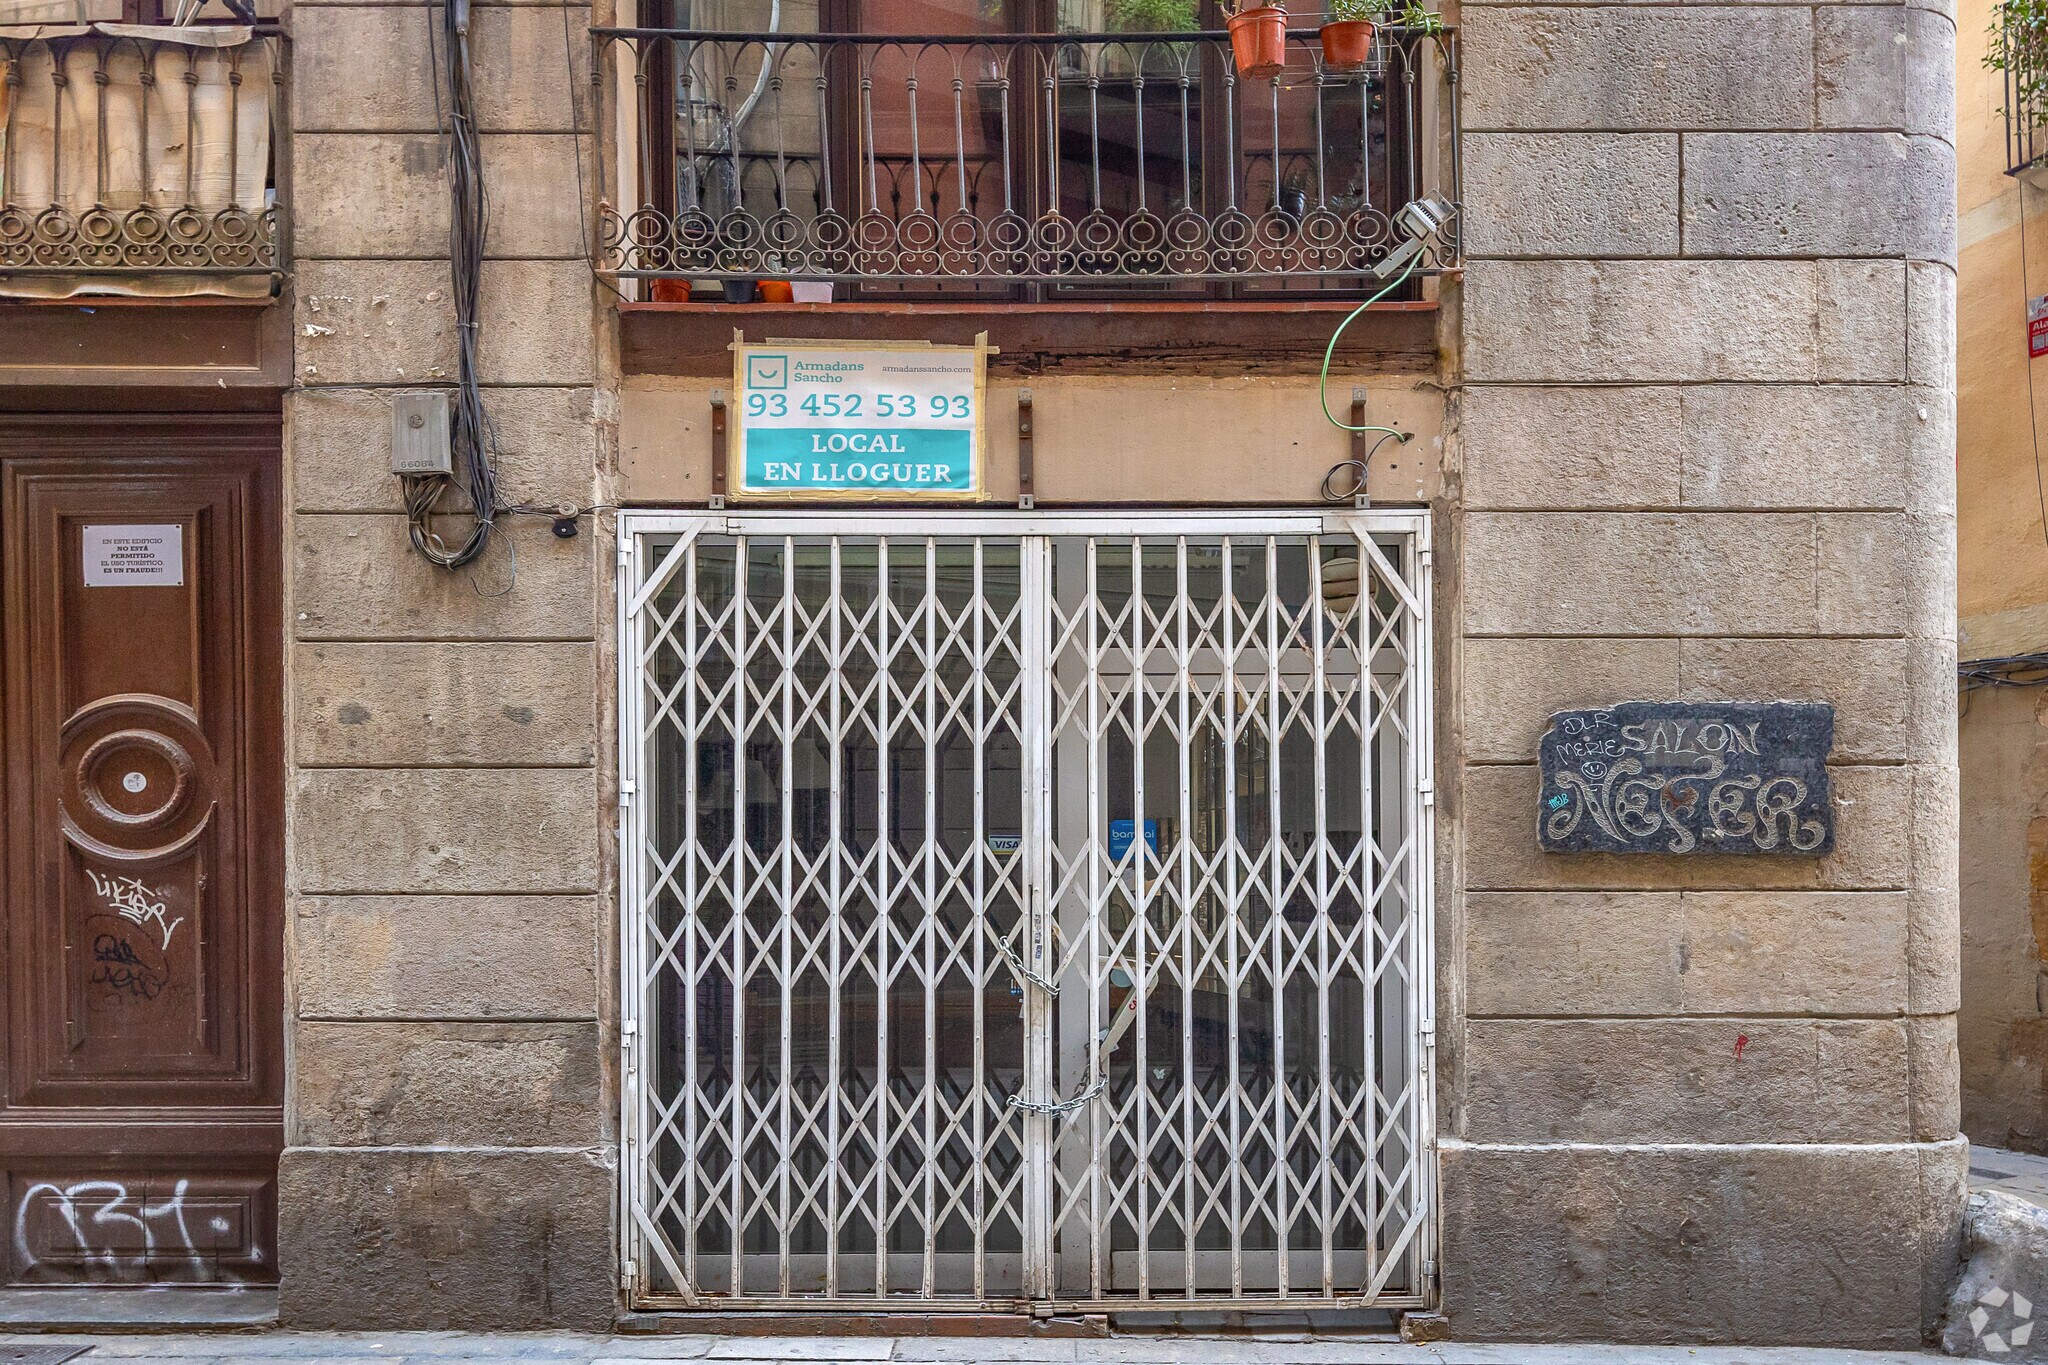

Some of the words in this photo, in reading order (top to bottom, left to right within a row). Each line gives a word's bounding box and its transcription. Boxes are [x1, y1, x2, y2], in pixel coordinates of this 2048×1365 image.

[794, 360, 865, 372] Armadans
[882, 365, 971, 374] armadanssancho.com
[794, 373, 843, 384] Sancho
[747, 393, 788, 417] 93
[800, 393, 863, 417] 452
[876, 394, 917, 418] 53
[930, 395, 971, 419] 93
[811, 433, 906, 454] LOCAL
[763, 462, 802, 481] EN
[811, 462, 952, 483] LLOGUER
[1620, 721, 1762, 756] SALON
[993, 840, 1020, 849] VISA
